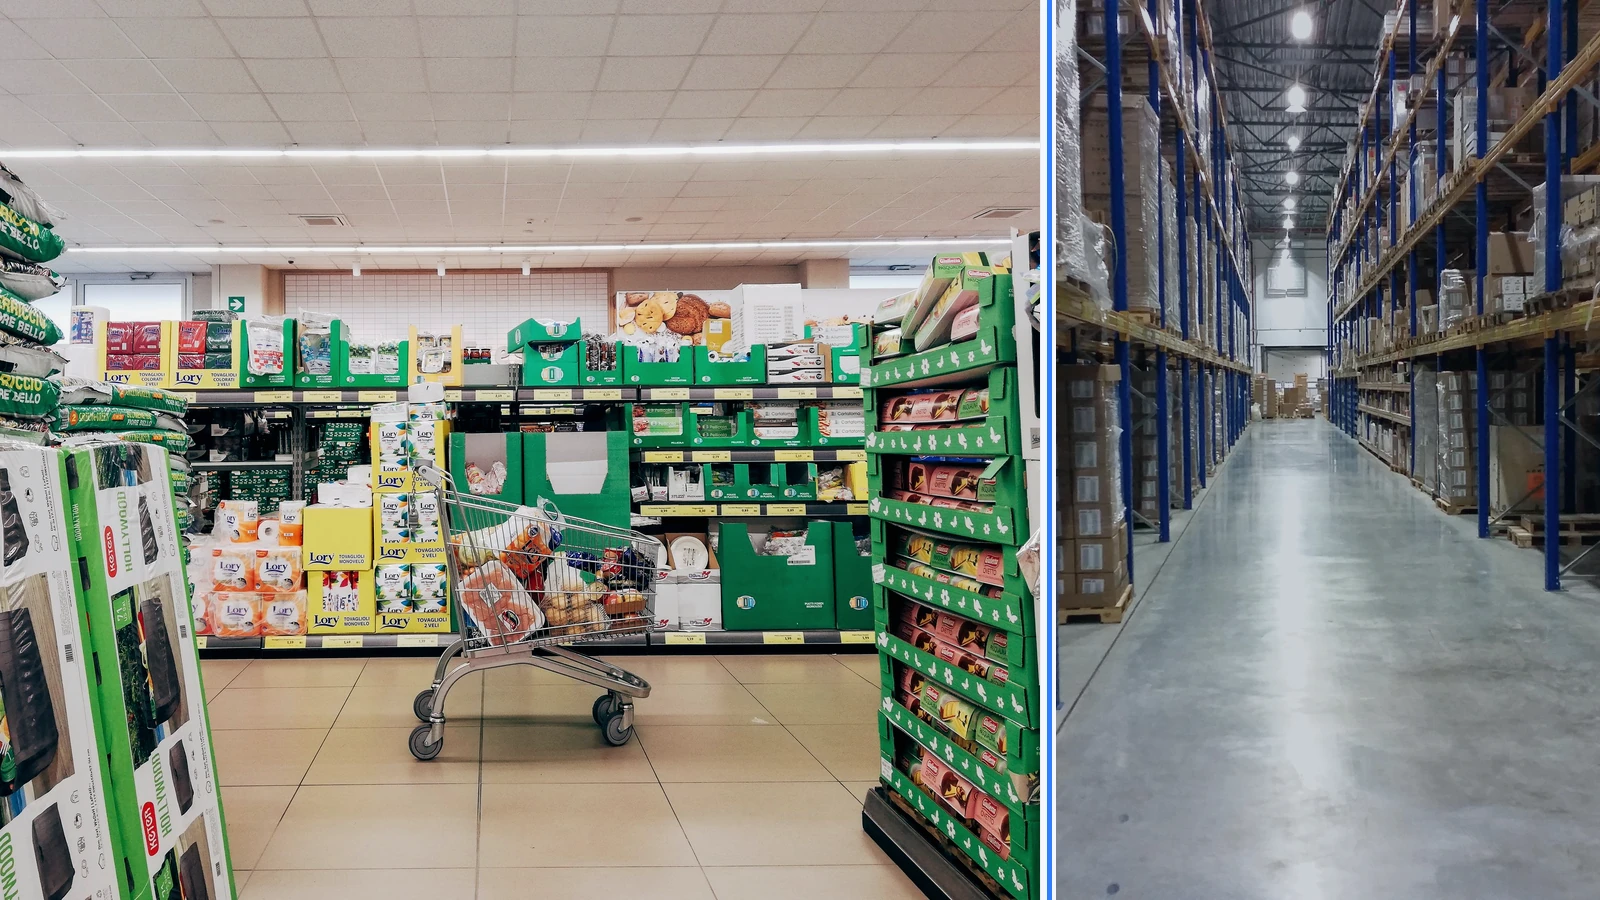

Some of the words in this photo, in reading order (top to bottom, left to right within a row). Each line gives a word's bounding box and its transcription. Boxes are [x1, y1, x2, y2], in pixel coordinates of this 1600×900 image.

[17, 320, 46, 341] BELLO
[104, 372, 131, 385] Lory
[175, 372, 203, 385] Lory
[12, 391, 41, 404] BELLO
[381, 431, 398, 439] Lory
[417, 430, 433, 438] Lory
[377, 475, 406, 488] Lory
[383, 502, 399, 510] Lory
[420, 502, 436, 510] Lory
[72, 503, 82, 541] HOLLYWOOD
[117, 491, 133, 573] HOLLYWOOD
[309, 552, 334, 565] Lory
[379, 546, 408, 560] Lory
[220, 561, 241, 573] Lory
[265, 562, 288, 573] Lory
[983, 567, 997, 576] OVETTO
[384, 572, 400, 580] Lory
[421, 572, 436, 580] Lory
[227, 605, 249, 617] Lory
[273, 605, 295, 617] Lory
[313, 615, 339, 628] Lory
[380, 615, 410, 629] Lory
[151, 753, 172, 837] HOLLYWOOD
